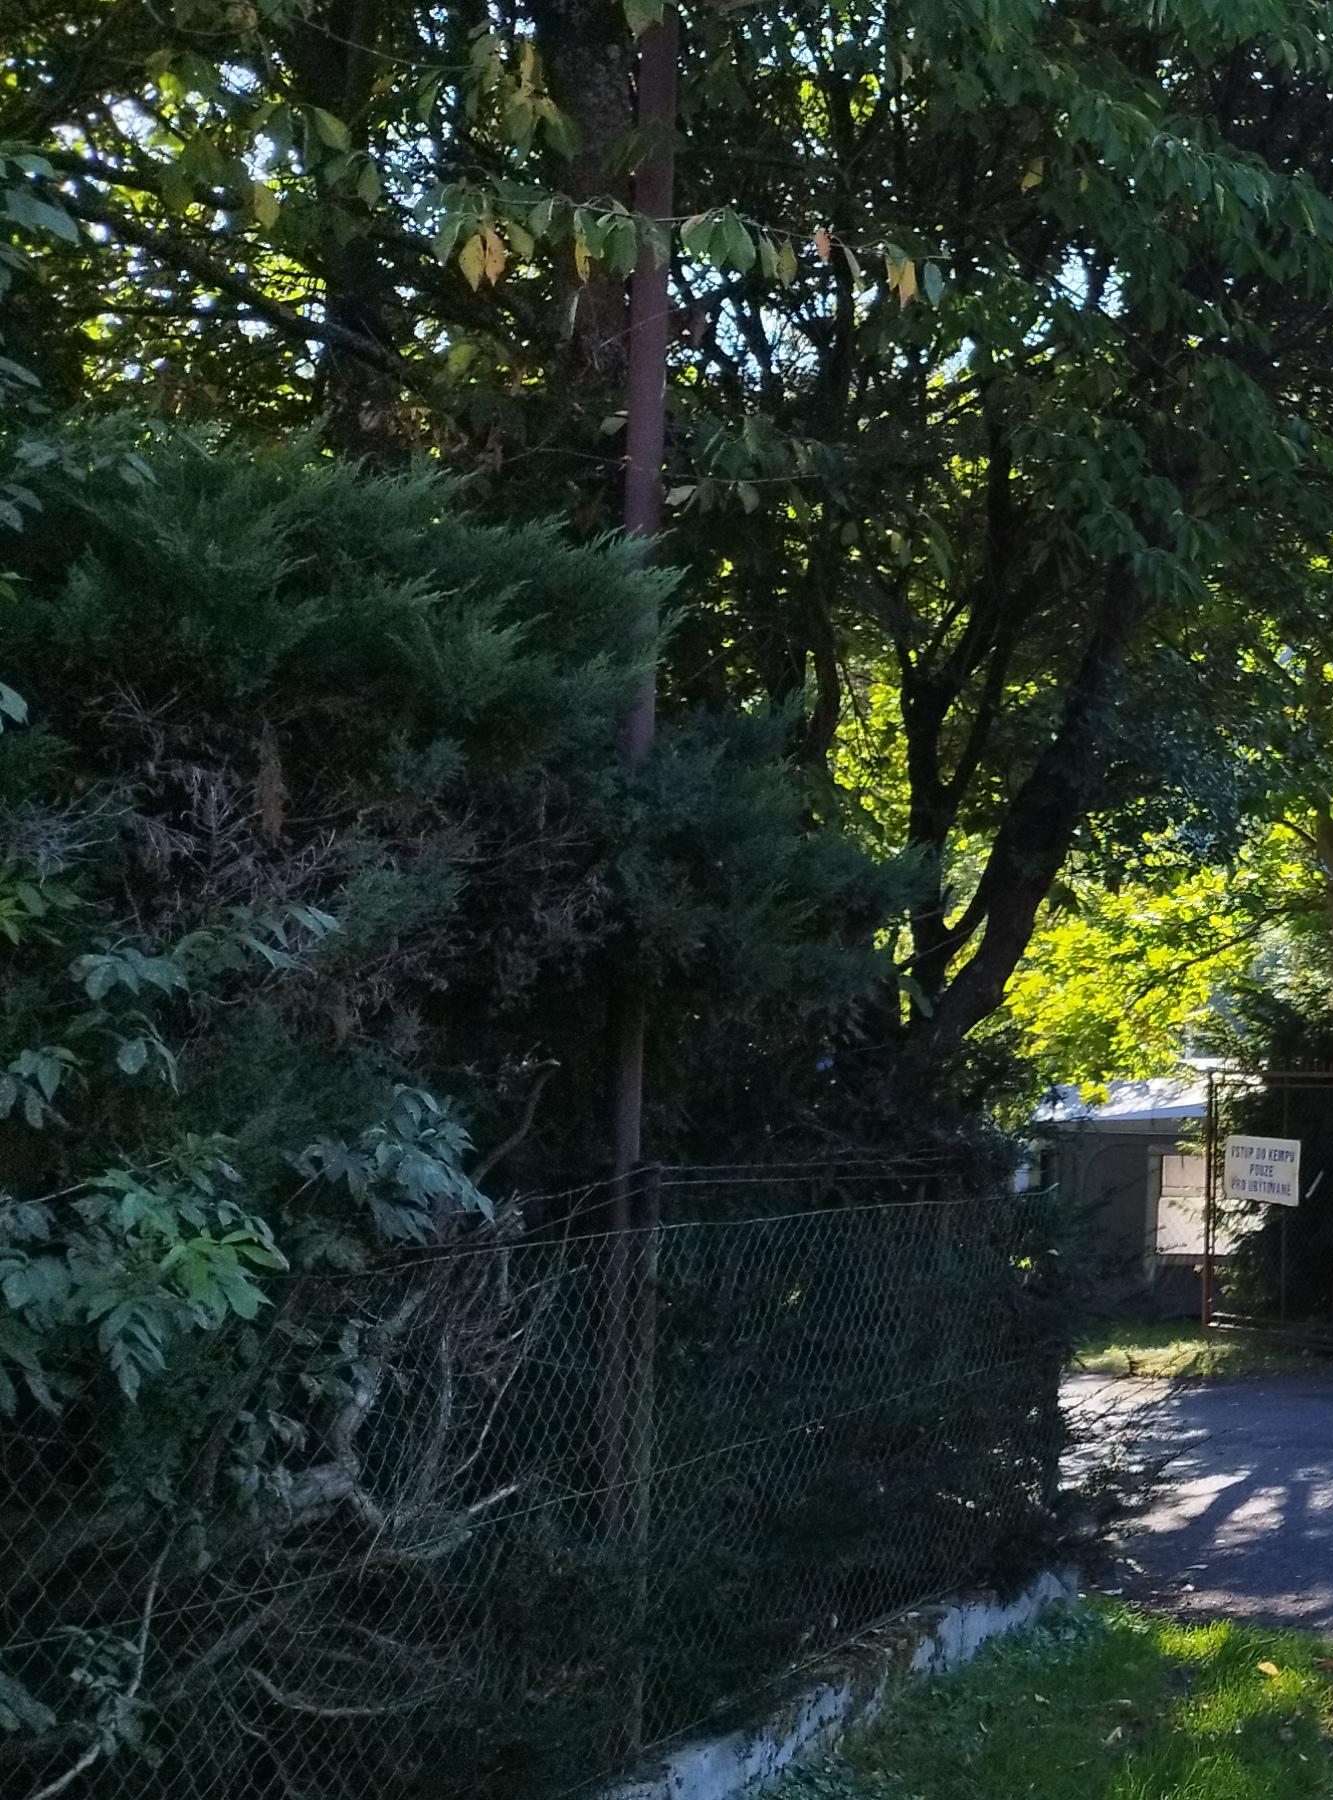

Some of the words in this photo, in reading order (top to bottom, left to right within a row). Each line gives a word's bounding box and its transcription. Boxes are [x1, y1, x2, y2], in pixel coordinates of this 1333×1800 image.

[1231, 1145, 1254, 1159] VSTUP
[1255, 1147, 1266, 1160] DO
[1268, 1148, 1296, 1163] KEMPU
[1249, 1163, 1274, 1178] POUZE
[1231, 1178, 1246, 1191] PRO
